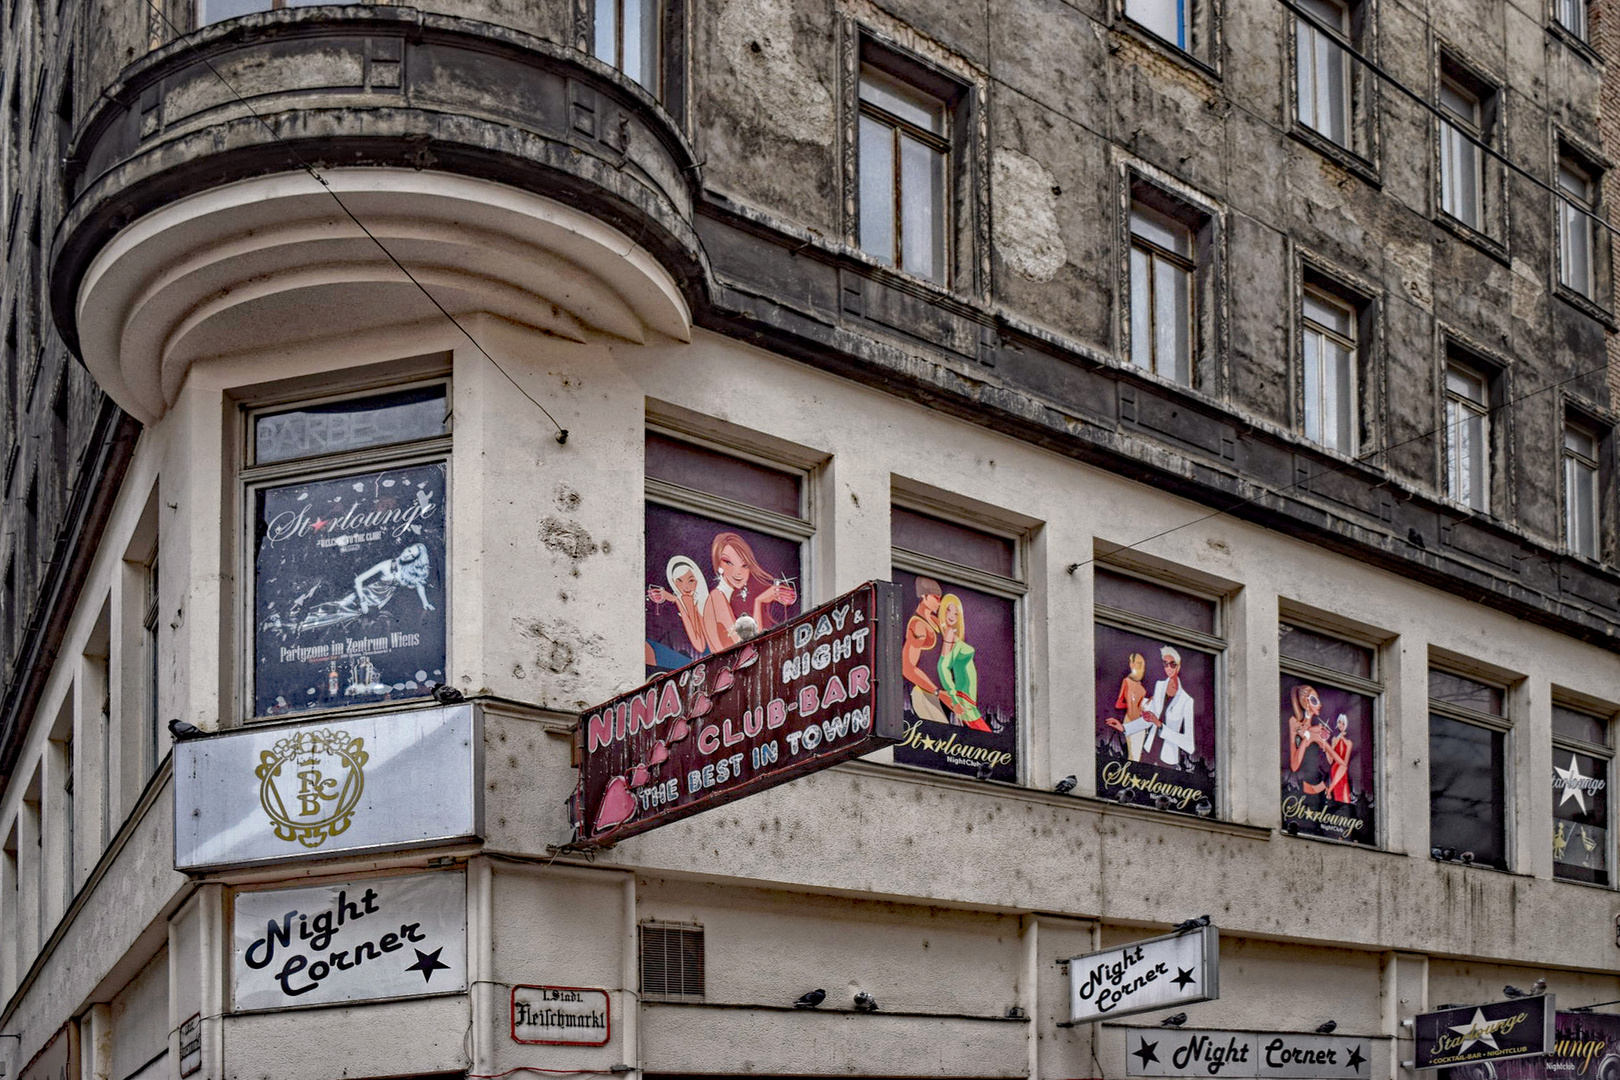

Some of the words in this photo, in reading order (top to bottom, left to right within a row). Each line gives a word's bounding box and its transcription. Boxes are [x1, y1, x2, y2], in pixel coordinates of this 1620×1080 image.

[280, 645, 329, 663] Partyzone
[331, 640, 344, 656] im
[346, 636, 388, 654] Zentrum
[390, 632, 420, 648] Wiens
[794, 605, 849, 649] DAY
[854, 609, 864, 624] &
[783, 627, 869, 684] NIGHT
[588, 664, 706, 753] NINA'S
[698, 665, 871, 755] CLUB-BAR
[639, 779, 679, 811] THE
[688, 753, 744, 793] BEST
[752, 739, 779, 769] IN
[786, 706, 871, 755] TOWN
[245, 889, 379, 970] Night
[275, 922, 426, 996] Corner
[1079, 946, 1145, 1000] Night
[1095, 961, 1169, 1012] Corner
[1172, 1035, 1249, 1075] Night
[1265, 1038, 1338, 1068] Corner
[1430, 1012, 1529, 1055] Starlounge
[1433, 1052, 1482, 1065] COCKTAIL-BAR
[1486, 1046, 1528, 1057] NIGHTCLUB
